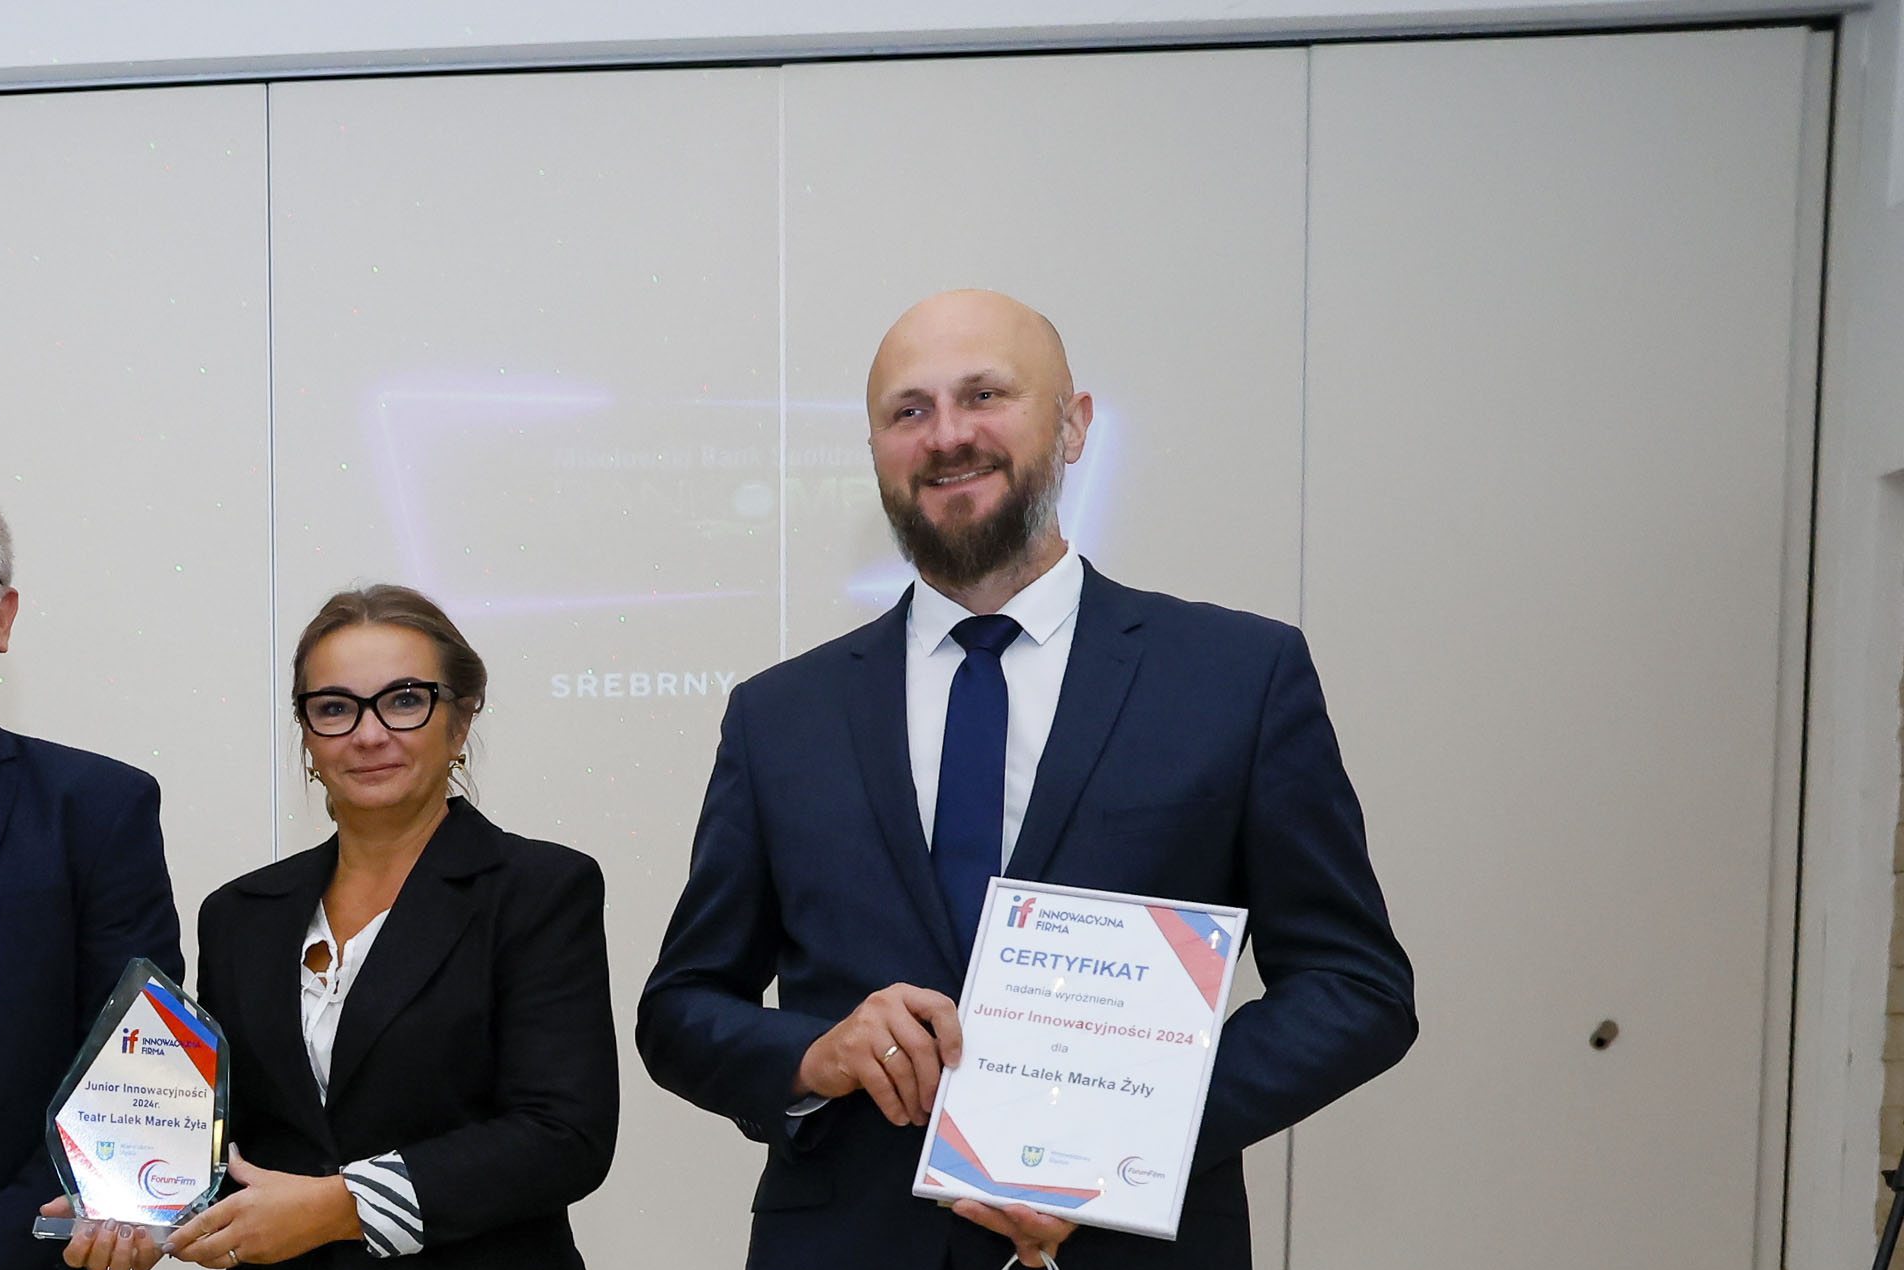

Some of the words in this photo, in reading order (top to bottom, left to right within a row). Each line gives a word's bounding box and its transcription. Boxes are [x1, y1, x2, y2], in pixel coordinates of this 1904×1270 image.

[551, 672, 736, 698] SREBRNY
[1038, 908, 1124, 928] INNOWACYJNA
[1035, 920, 1070, 934] FIRMA
[1000, 947, 1149, 981] CERTYFIKAT
[1005, 983, 1052, 998] nadania
[974, 1003, 1024, 1021] Junior
[1027, 1011, 1152, 1039] Innowacyjności
[1156, 1029, 1194, 1045] 2024
[142, 1038, 201, 1048] INNOWAC
[1051, 1043, 1069, 1054] dla
[141, 1047, 165, 1056] FIRMA
[977, 1058, 1017, 1075] Teatr
[1020, 1064, 1063, 1082] Lalek
[1067, 1071, 1117, 1090] Marka
[1120, 1077, 1155, 1098] Żyły
[84, 1081, 120, 1092] Junior
[123, 1083, 207, 1098] Innowacyjności
[132, 1099, 161, 1109] 2024r.
[78, 1111, 107, 1122] Teatr
[110, 1113, 141, 1125] Lalek
[145, 1115, 180, 1128] Marek
[184, 1116, 207, 1131] Żyła
[151, 1175, 196, 1186] ForumFirm
